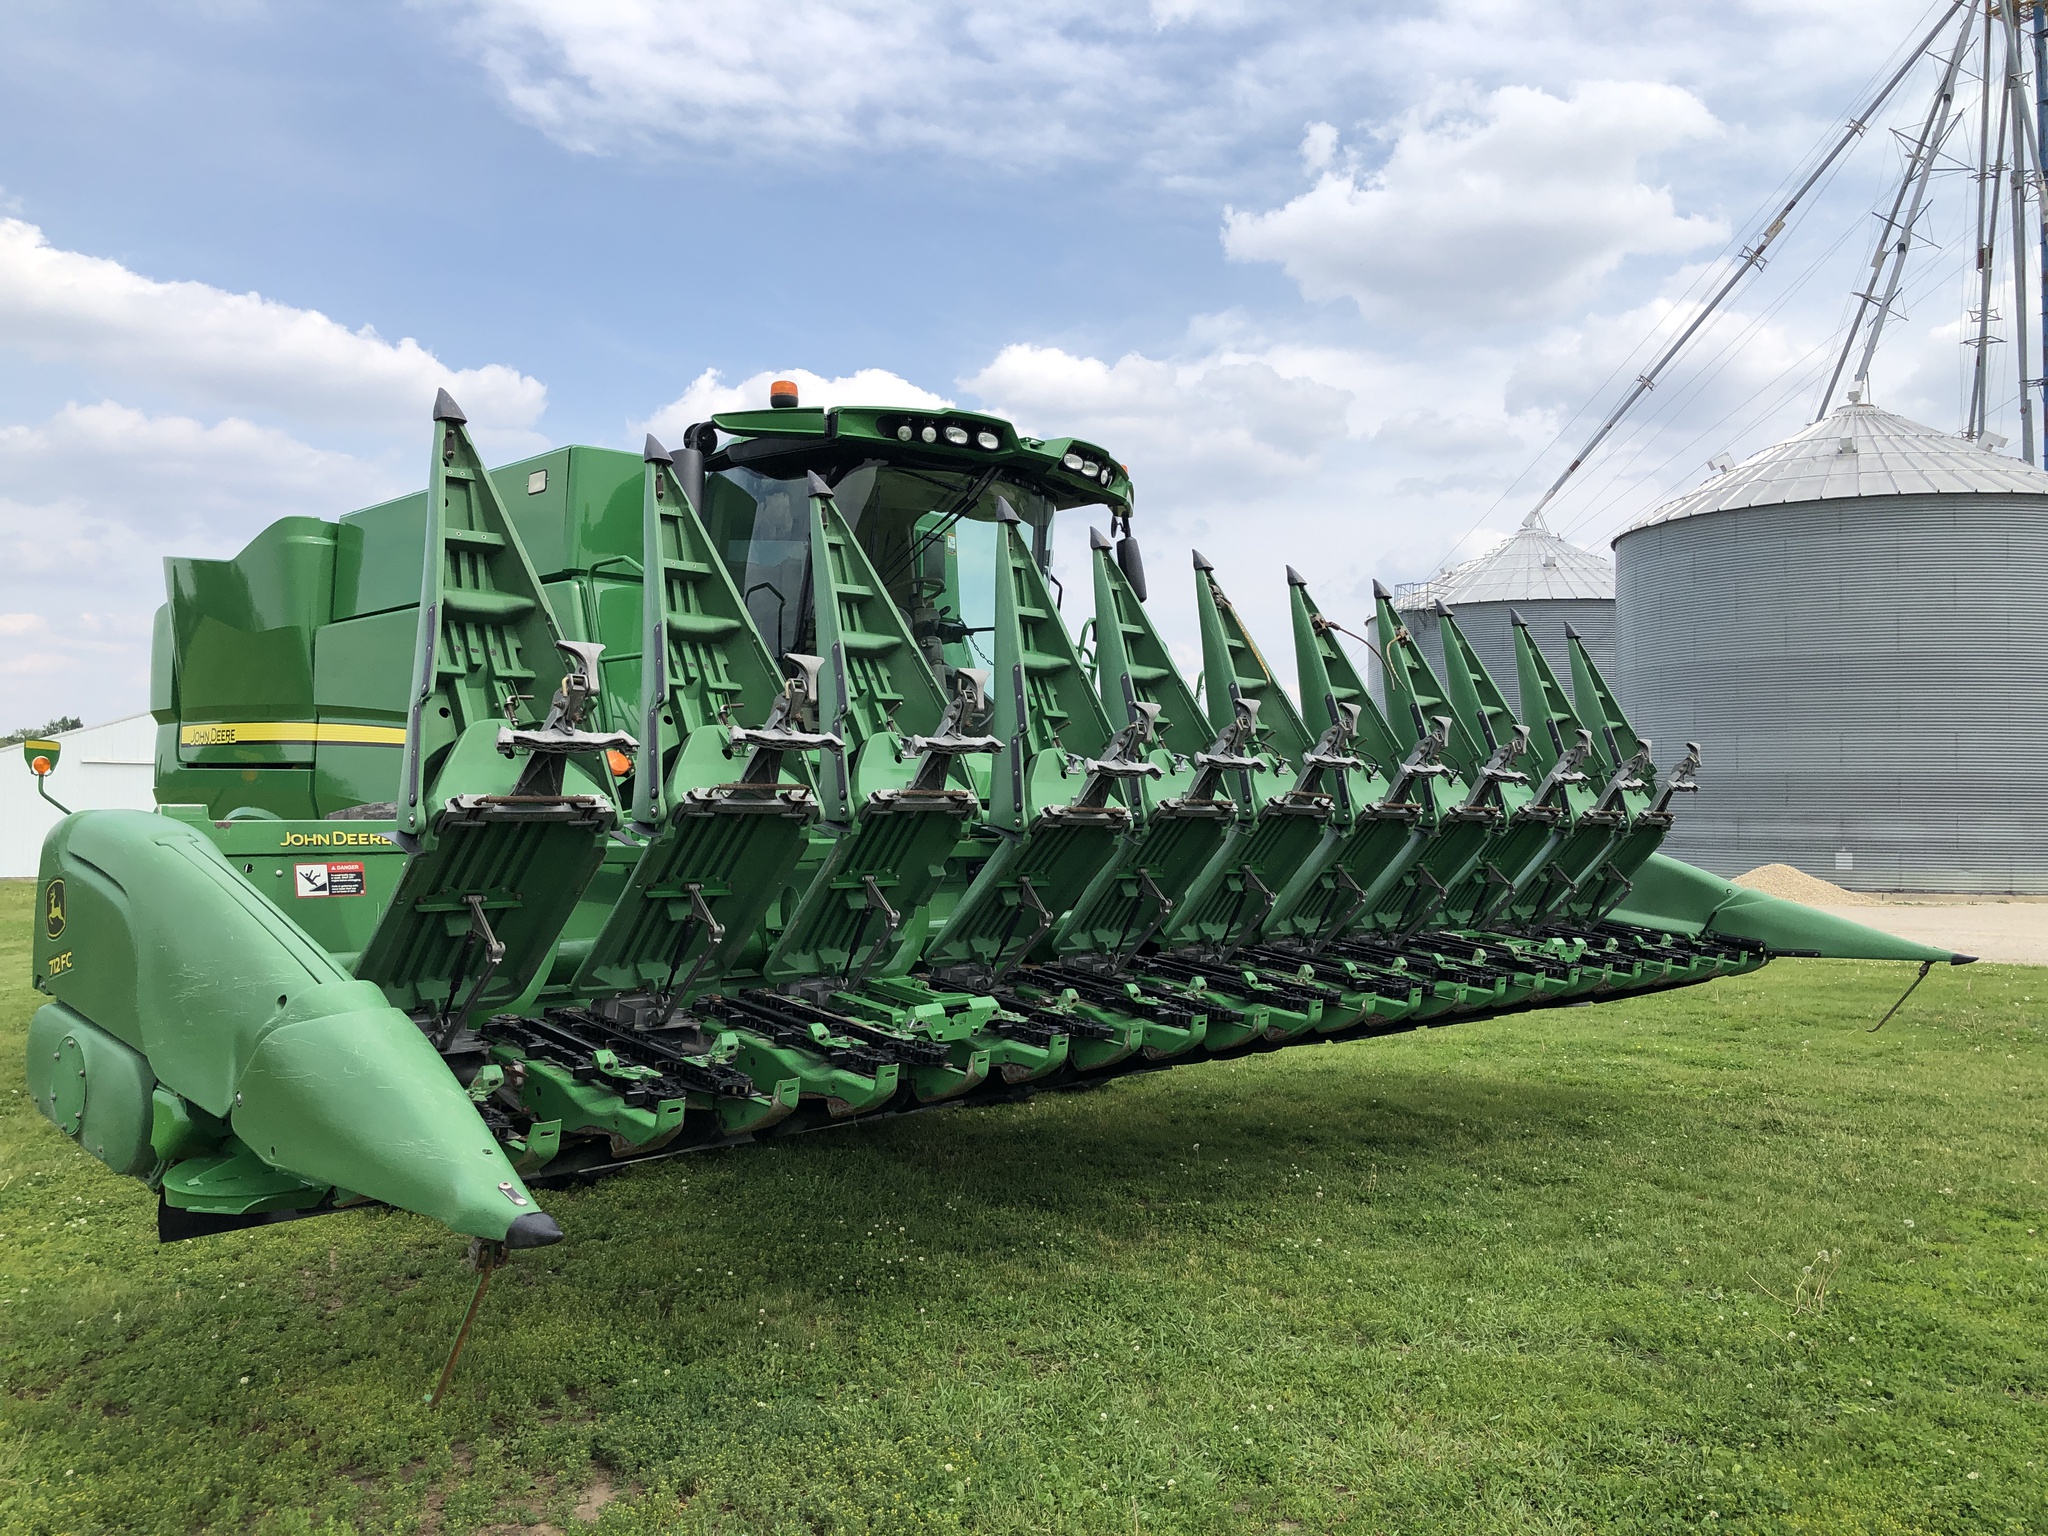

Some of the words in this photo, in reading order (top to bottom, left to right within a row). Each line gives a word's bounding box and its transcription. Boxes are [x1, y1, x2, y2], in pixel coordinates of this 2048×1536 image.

[190, 729, 210, 743] JOHN
[210, 727, 236, 742] DEERE
[280, 831, 330, 847] JOHN
